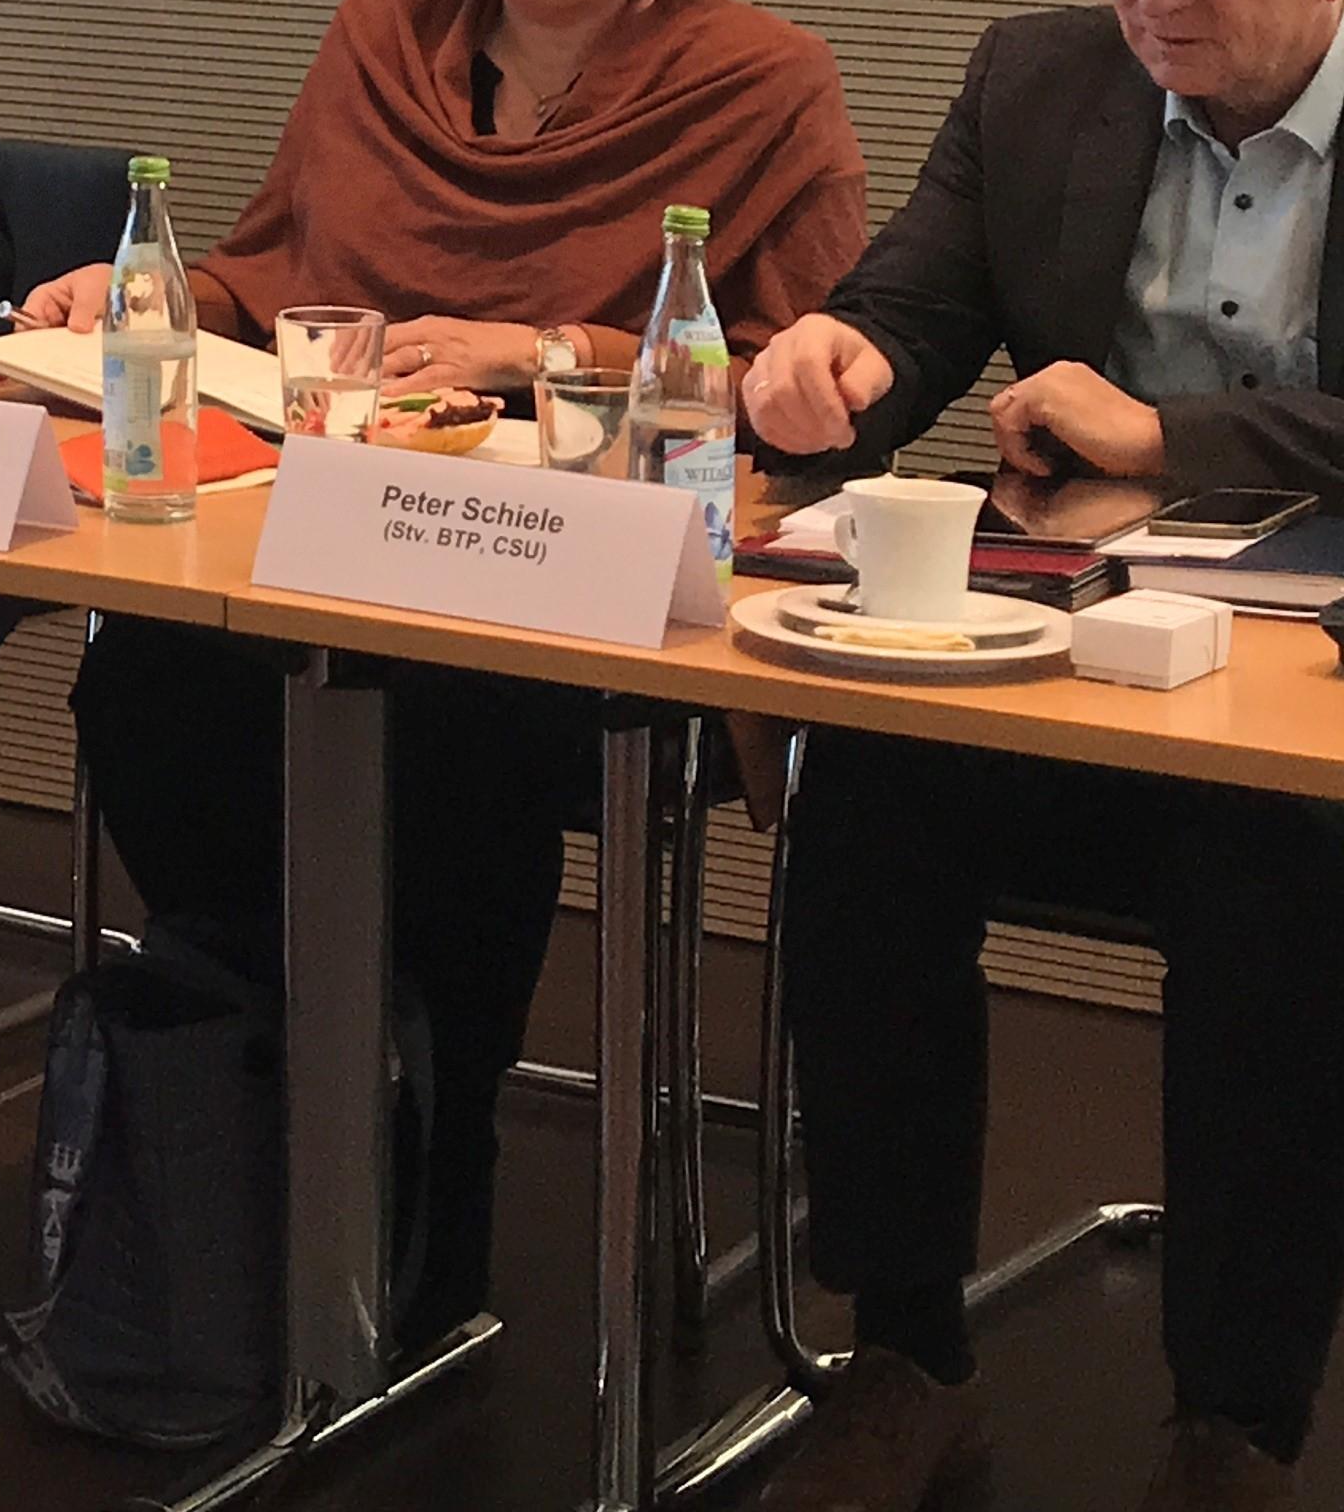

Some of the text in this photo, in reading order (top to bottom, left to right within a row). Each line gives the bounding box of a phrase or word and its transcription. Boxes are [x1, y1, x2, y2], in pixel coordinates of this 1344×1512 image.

[381, 485, 565, 534] Peter Schiele
[383, 519, 547, 566] (Stv. BTP, CSU)
